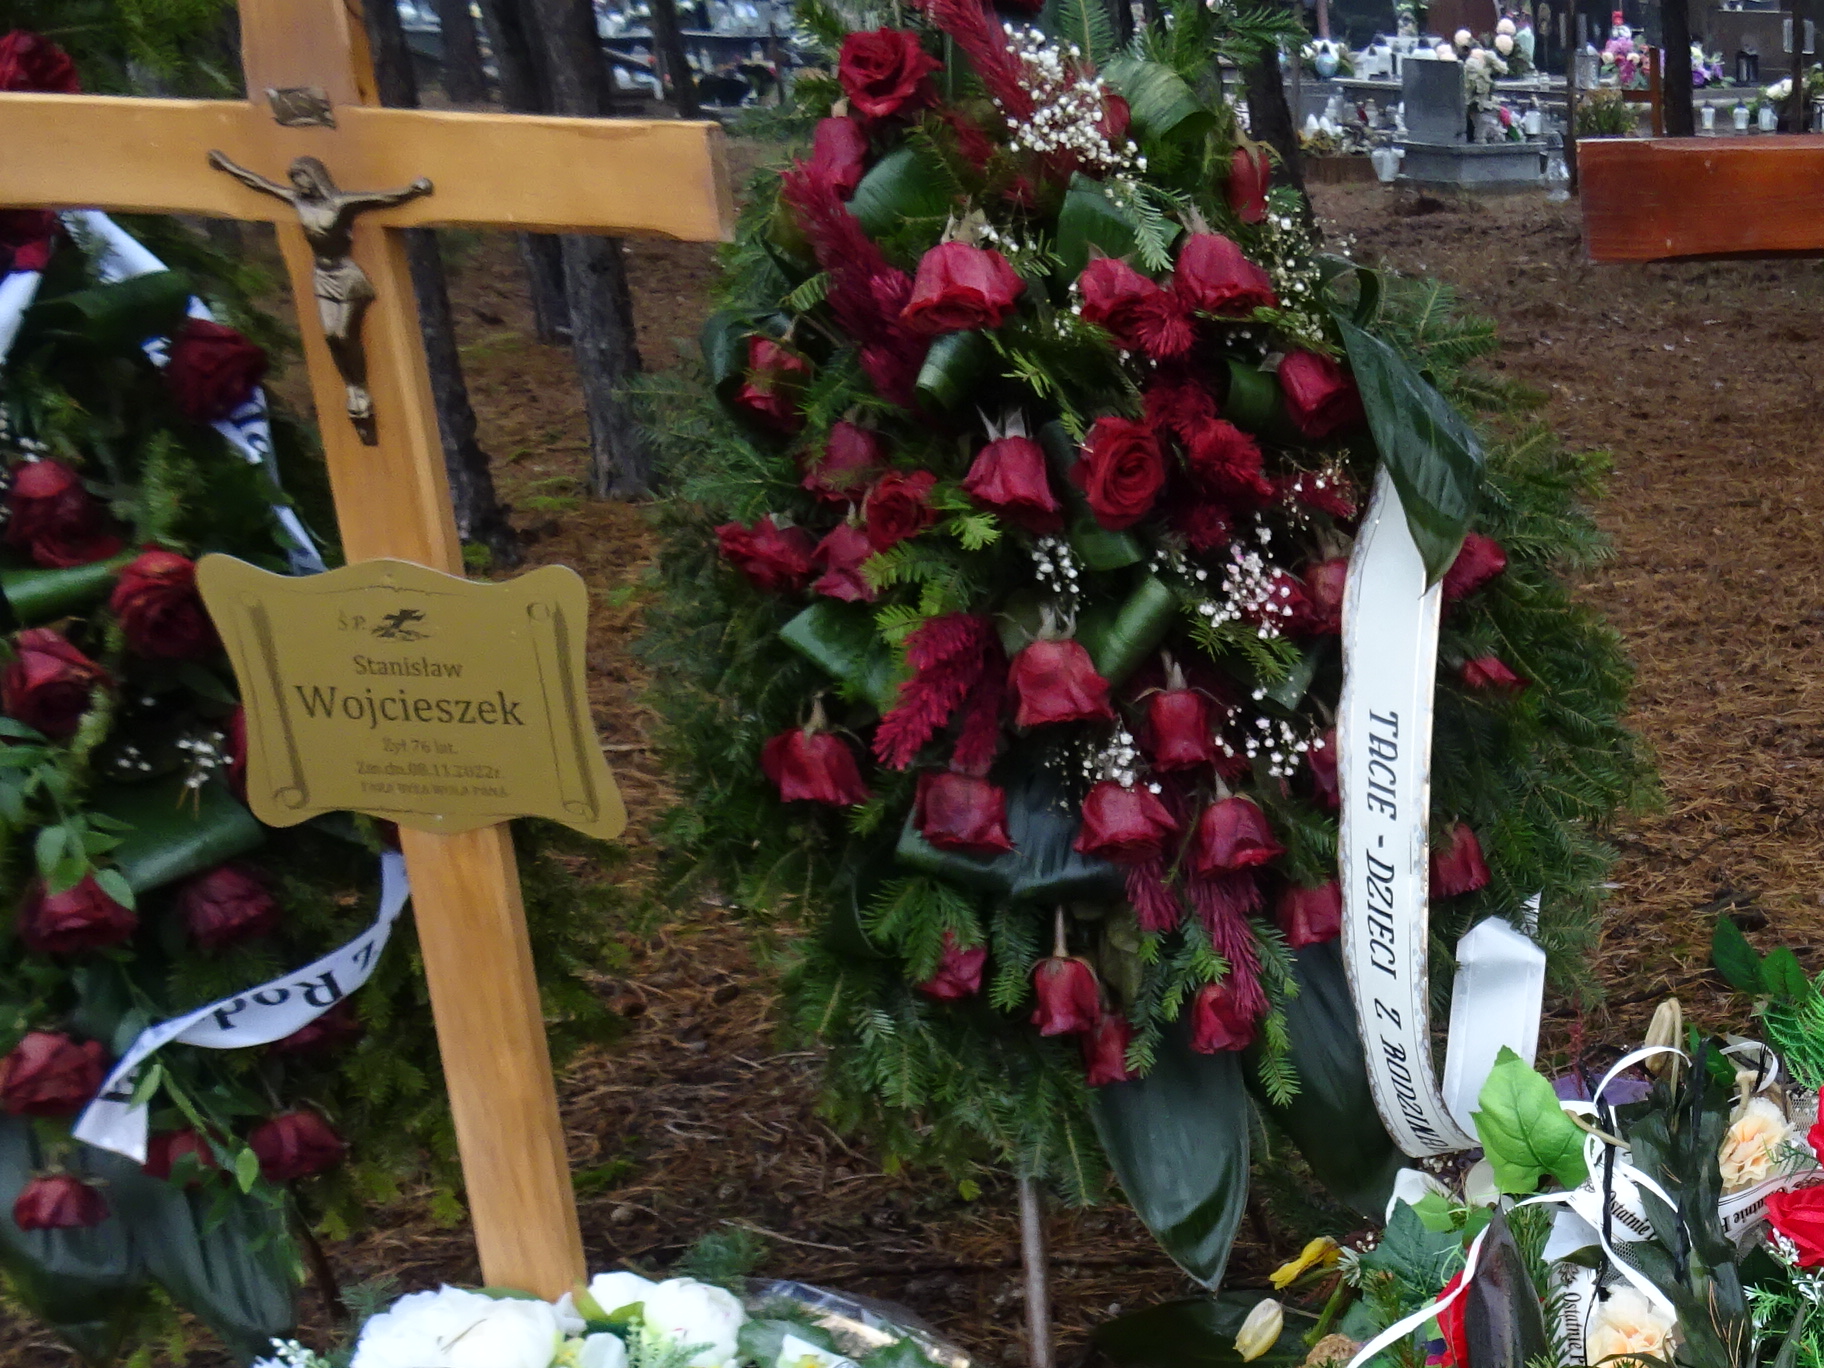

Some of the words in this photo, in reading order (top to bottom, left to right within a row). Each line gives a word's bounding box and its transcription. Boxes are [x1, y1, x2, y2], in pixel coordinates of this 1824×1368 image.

[353, 654, 464, 678] Stanisław
[293, 685, 526, 729] Wojcieszek
[1366, 708, 1399, 822] TACIE
[1365, 848, 1397, 981] DZIECI
[1563, 1292, 1583, 1352] Ostatnie
